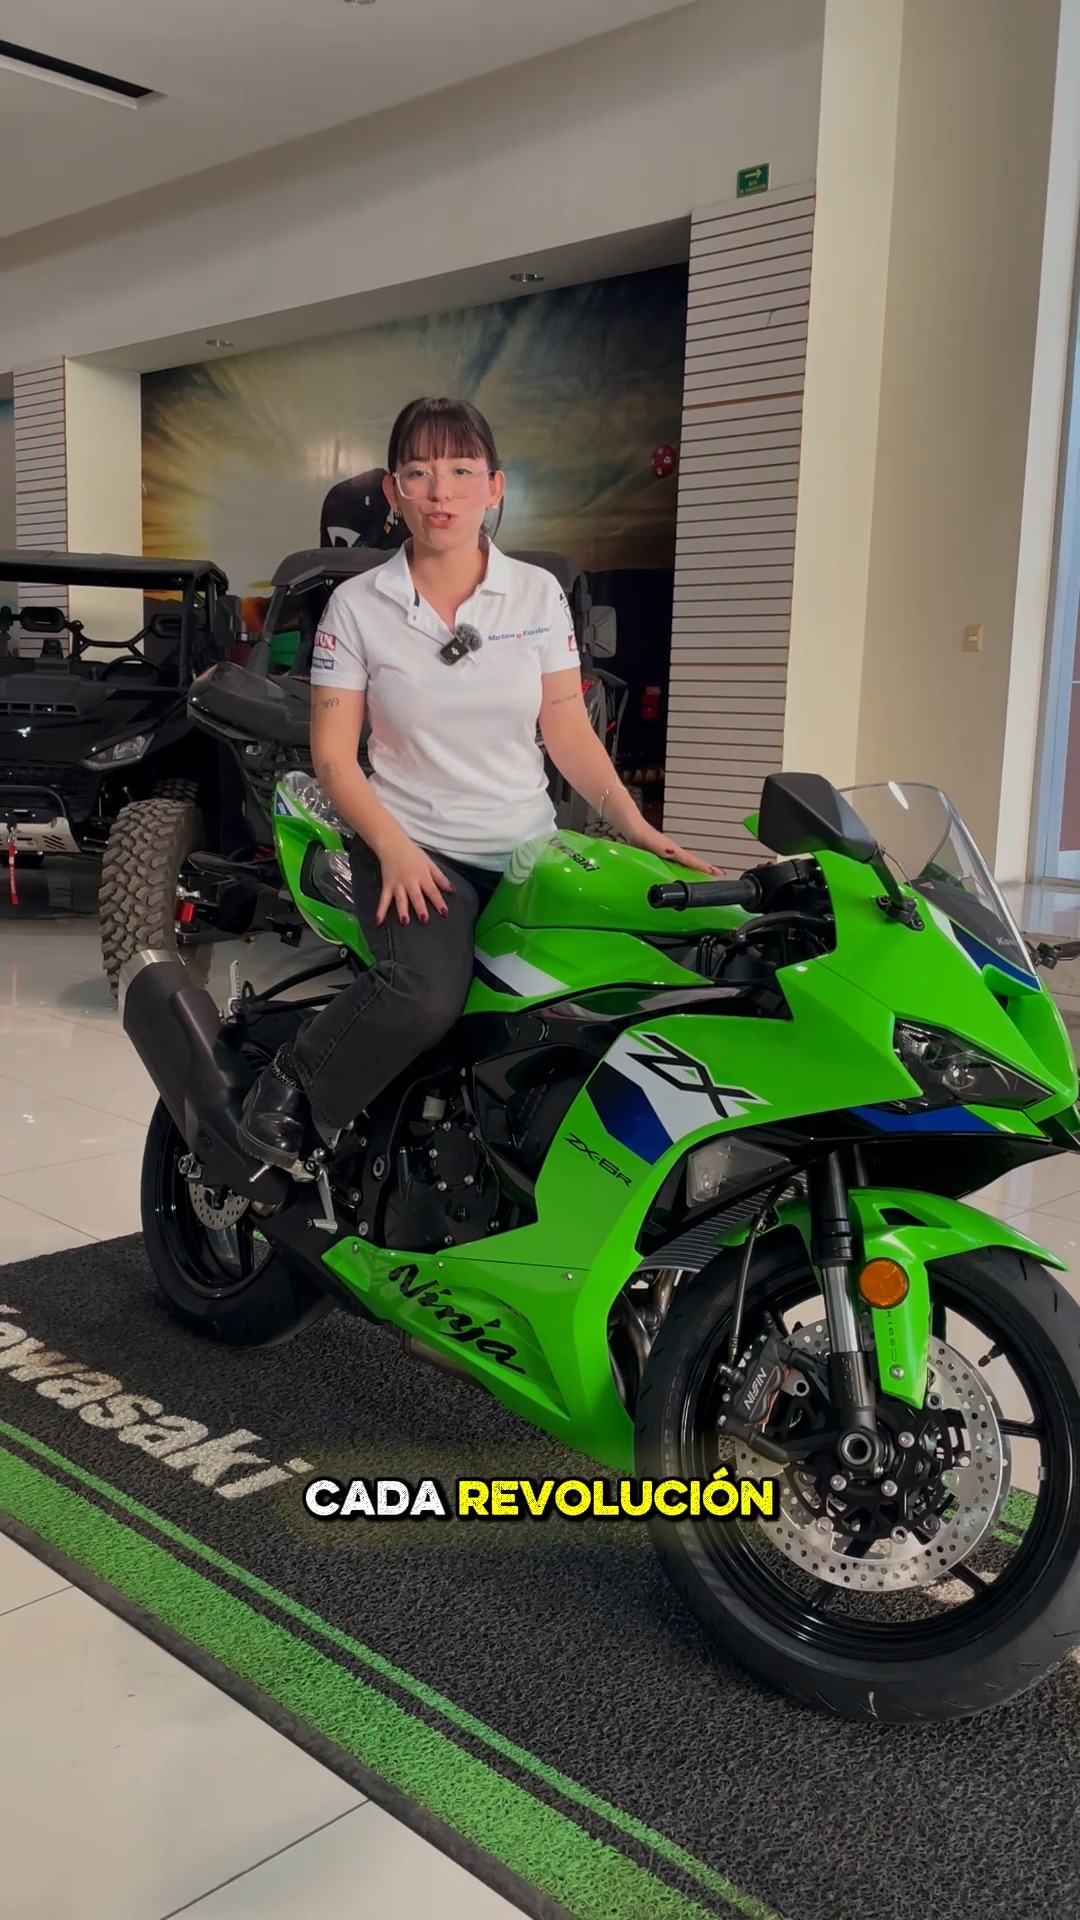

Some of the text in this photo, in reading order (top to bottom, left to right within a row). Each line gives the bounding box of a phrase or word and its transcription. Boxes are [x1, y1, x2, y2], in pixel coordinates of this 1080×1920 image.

[487, 626, 552, 641] Motos y Equipo
[563, 1132, 633, 1188] ZX-6R
[387, 1262, 527, 1376] Ninja
[0, 1303, 315, 1500] wasaki
[743, 1367, 767, 1410] NISSIN
